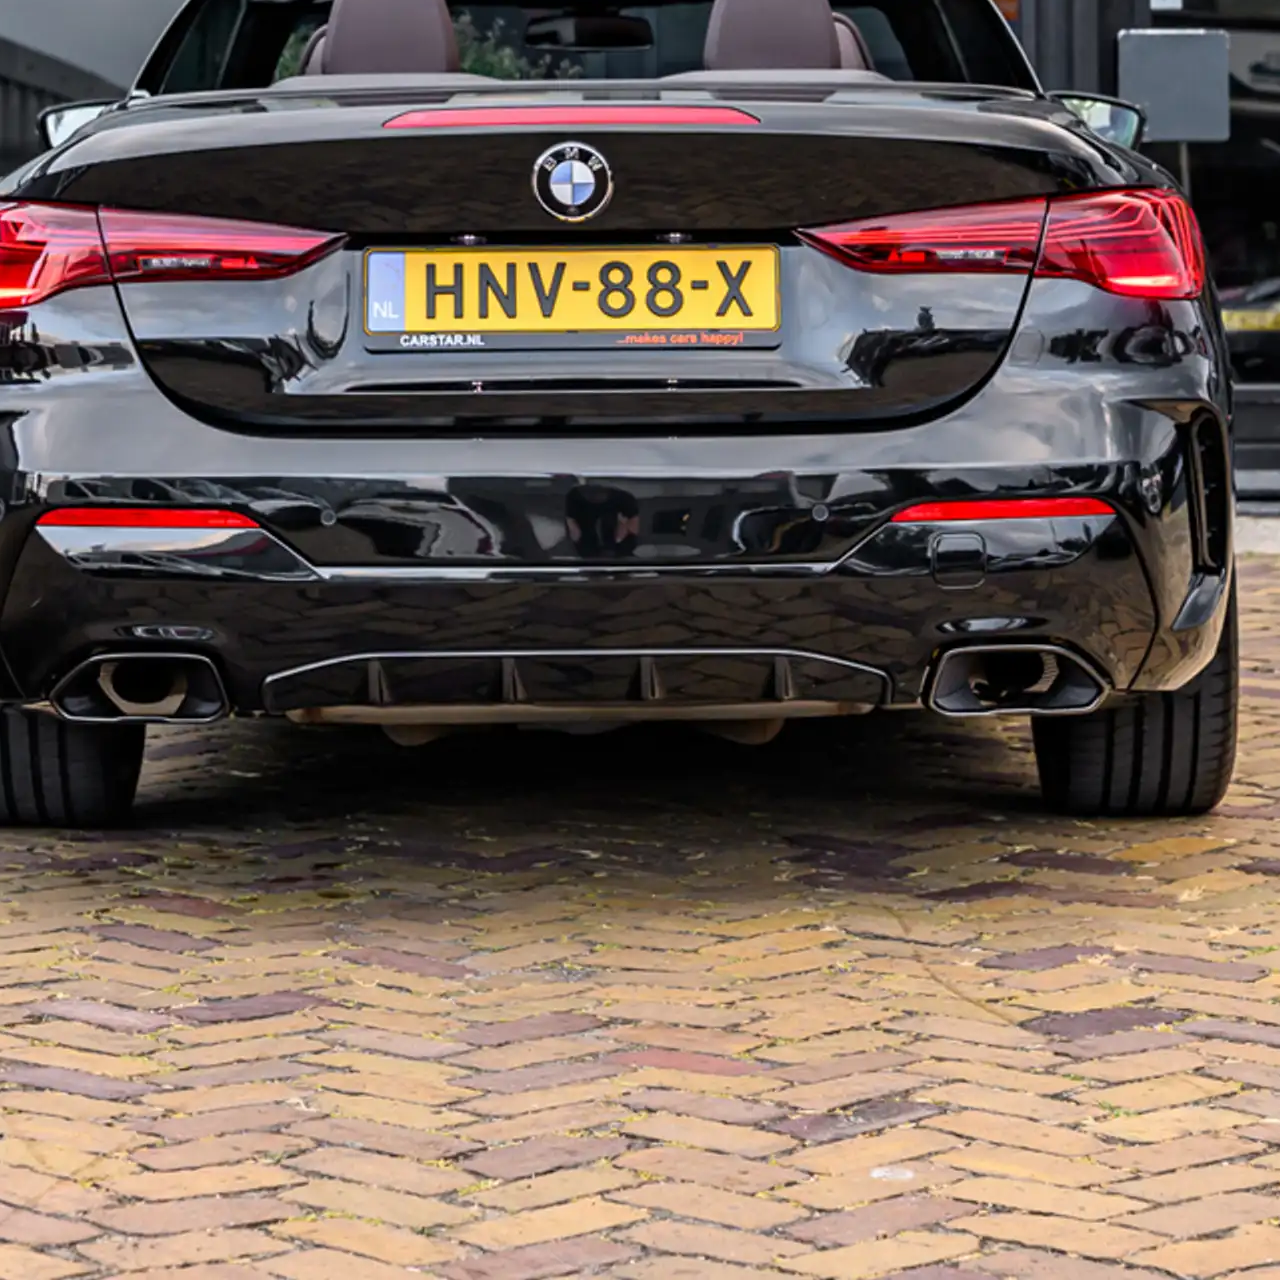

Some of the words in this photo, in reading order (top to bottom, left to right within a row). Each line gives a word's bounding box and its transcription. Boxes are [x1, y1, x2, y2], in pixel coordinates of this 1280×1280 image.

[541, 146, 603, 172] BMW
[425, 259, 754, 320] HNV-88-X
[372, 301, 399, 319] NL
[399, 334, 485, 347] CARSTAR.NL
[669, 334, 698, 345] cars
[700, 332, 744, 346] happy!
